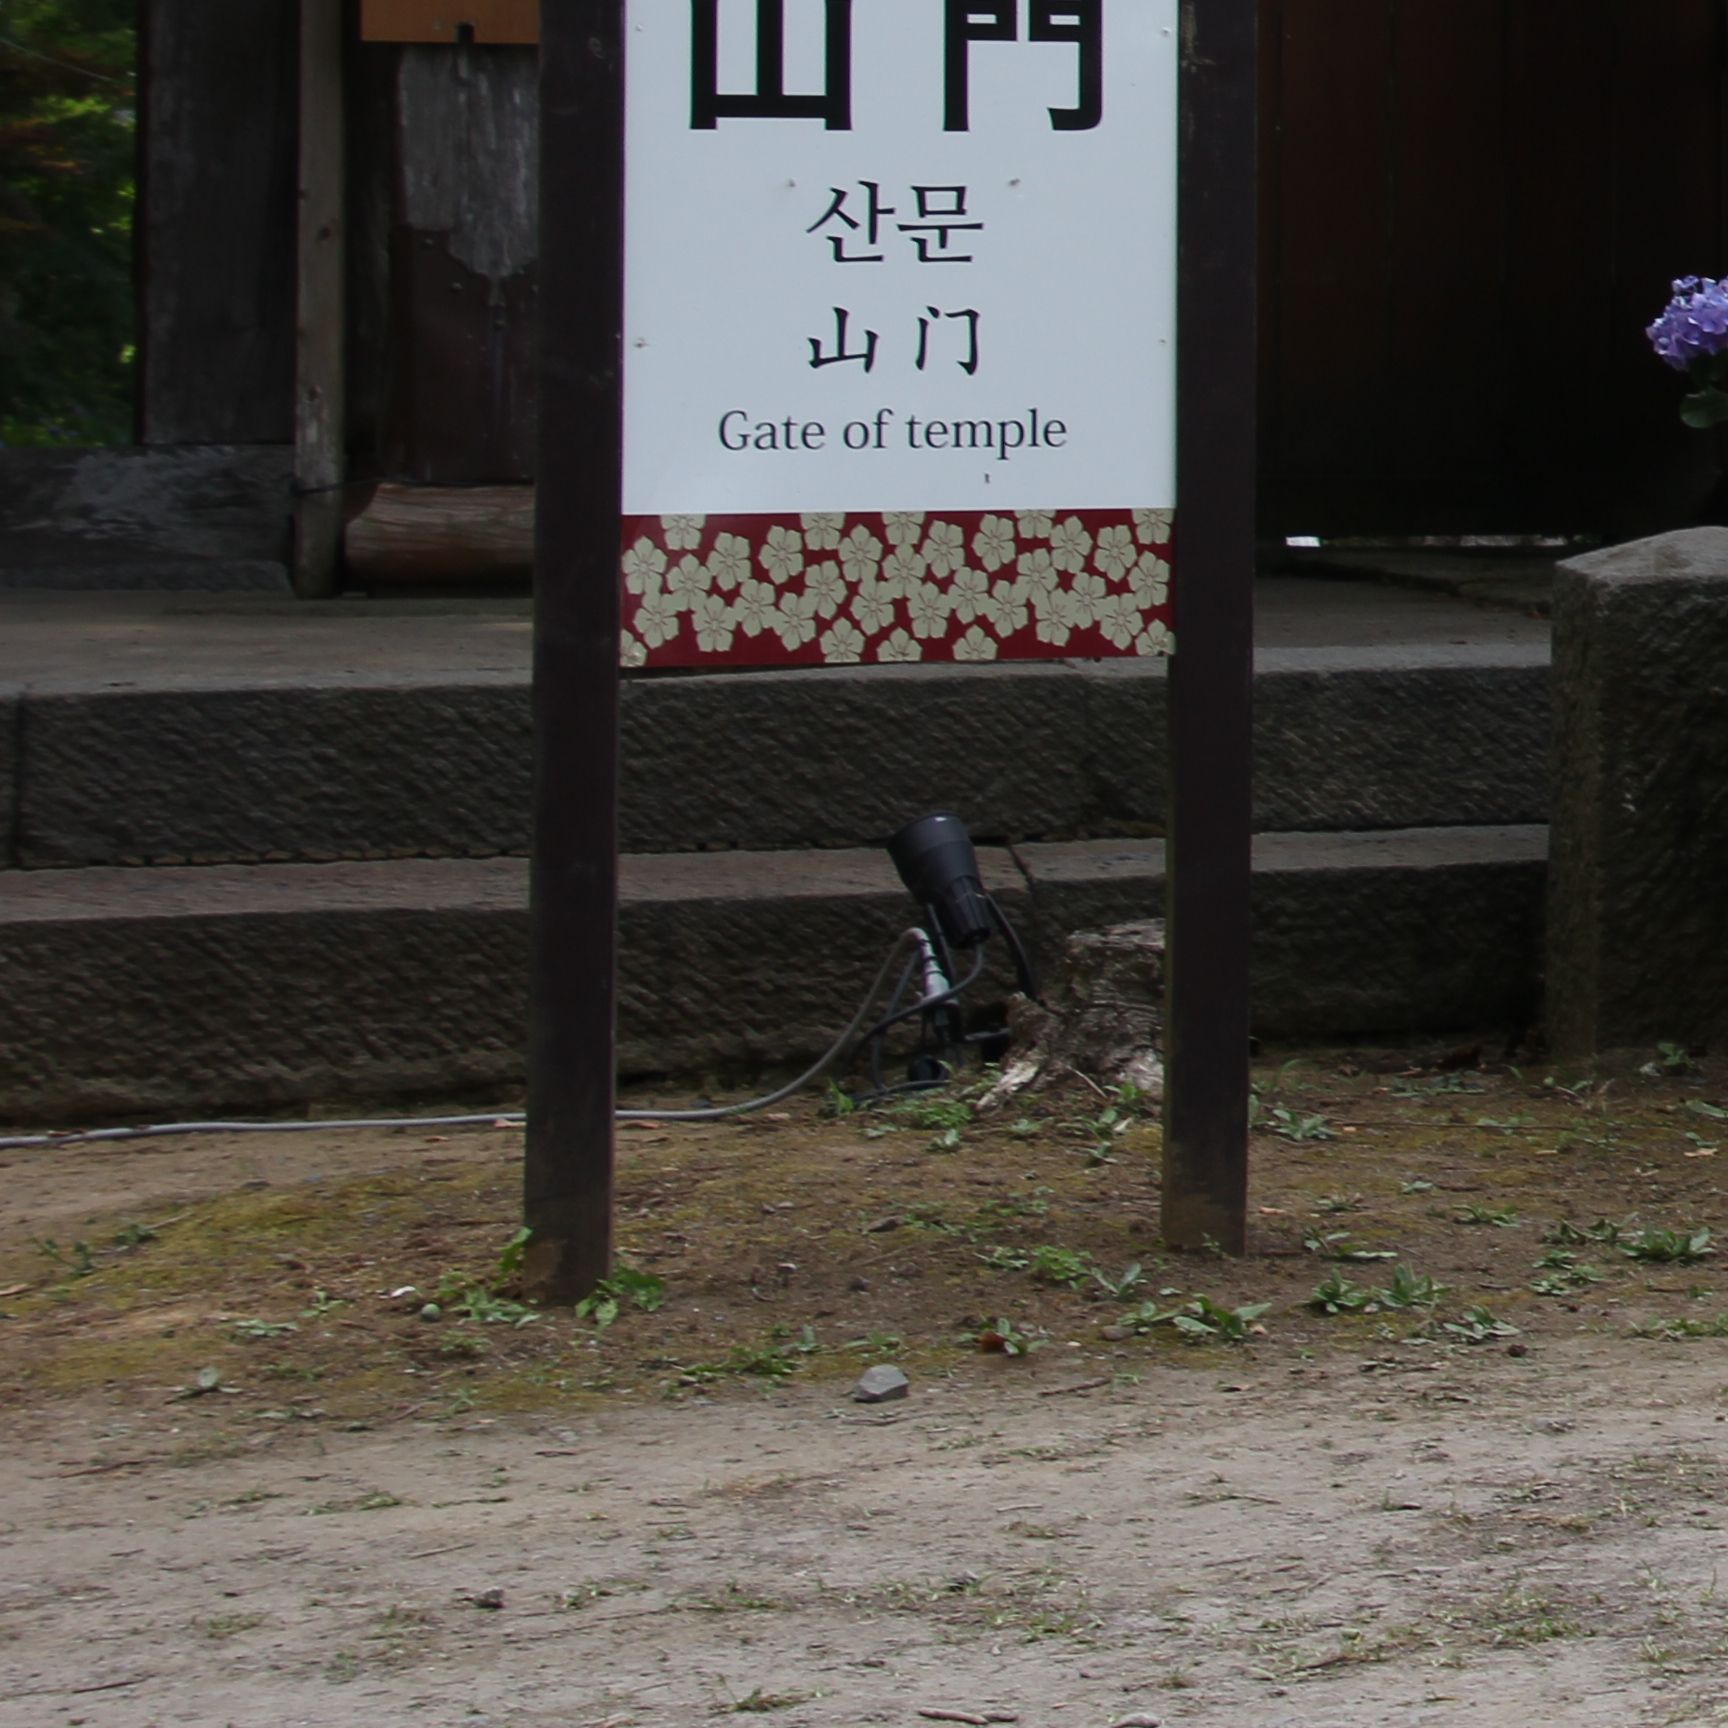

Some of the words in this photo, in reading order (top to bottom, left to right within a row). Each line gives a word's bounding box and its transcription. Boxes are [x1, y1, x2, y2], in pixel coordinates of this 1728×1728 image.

[806, 180, 984, 263] 산문
[808, 306, 982, 376] 山门
[718, 409, 826, 451] Gate
[843, 408, 893, 450] of
[906, 407, 1067, 461] temple
